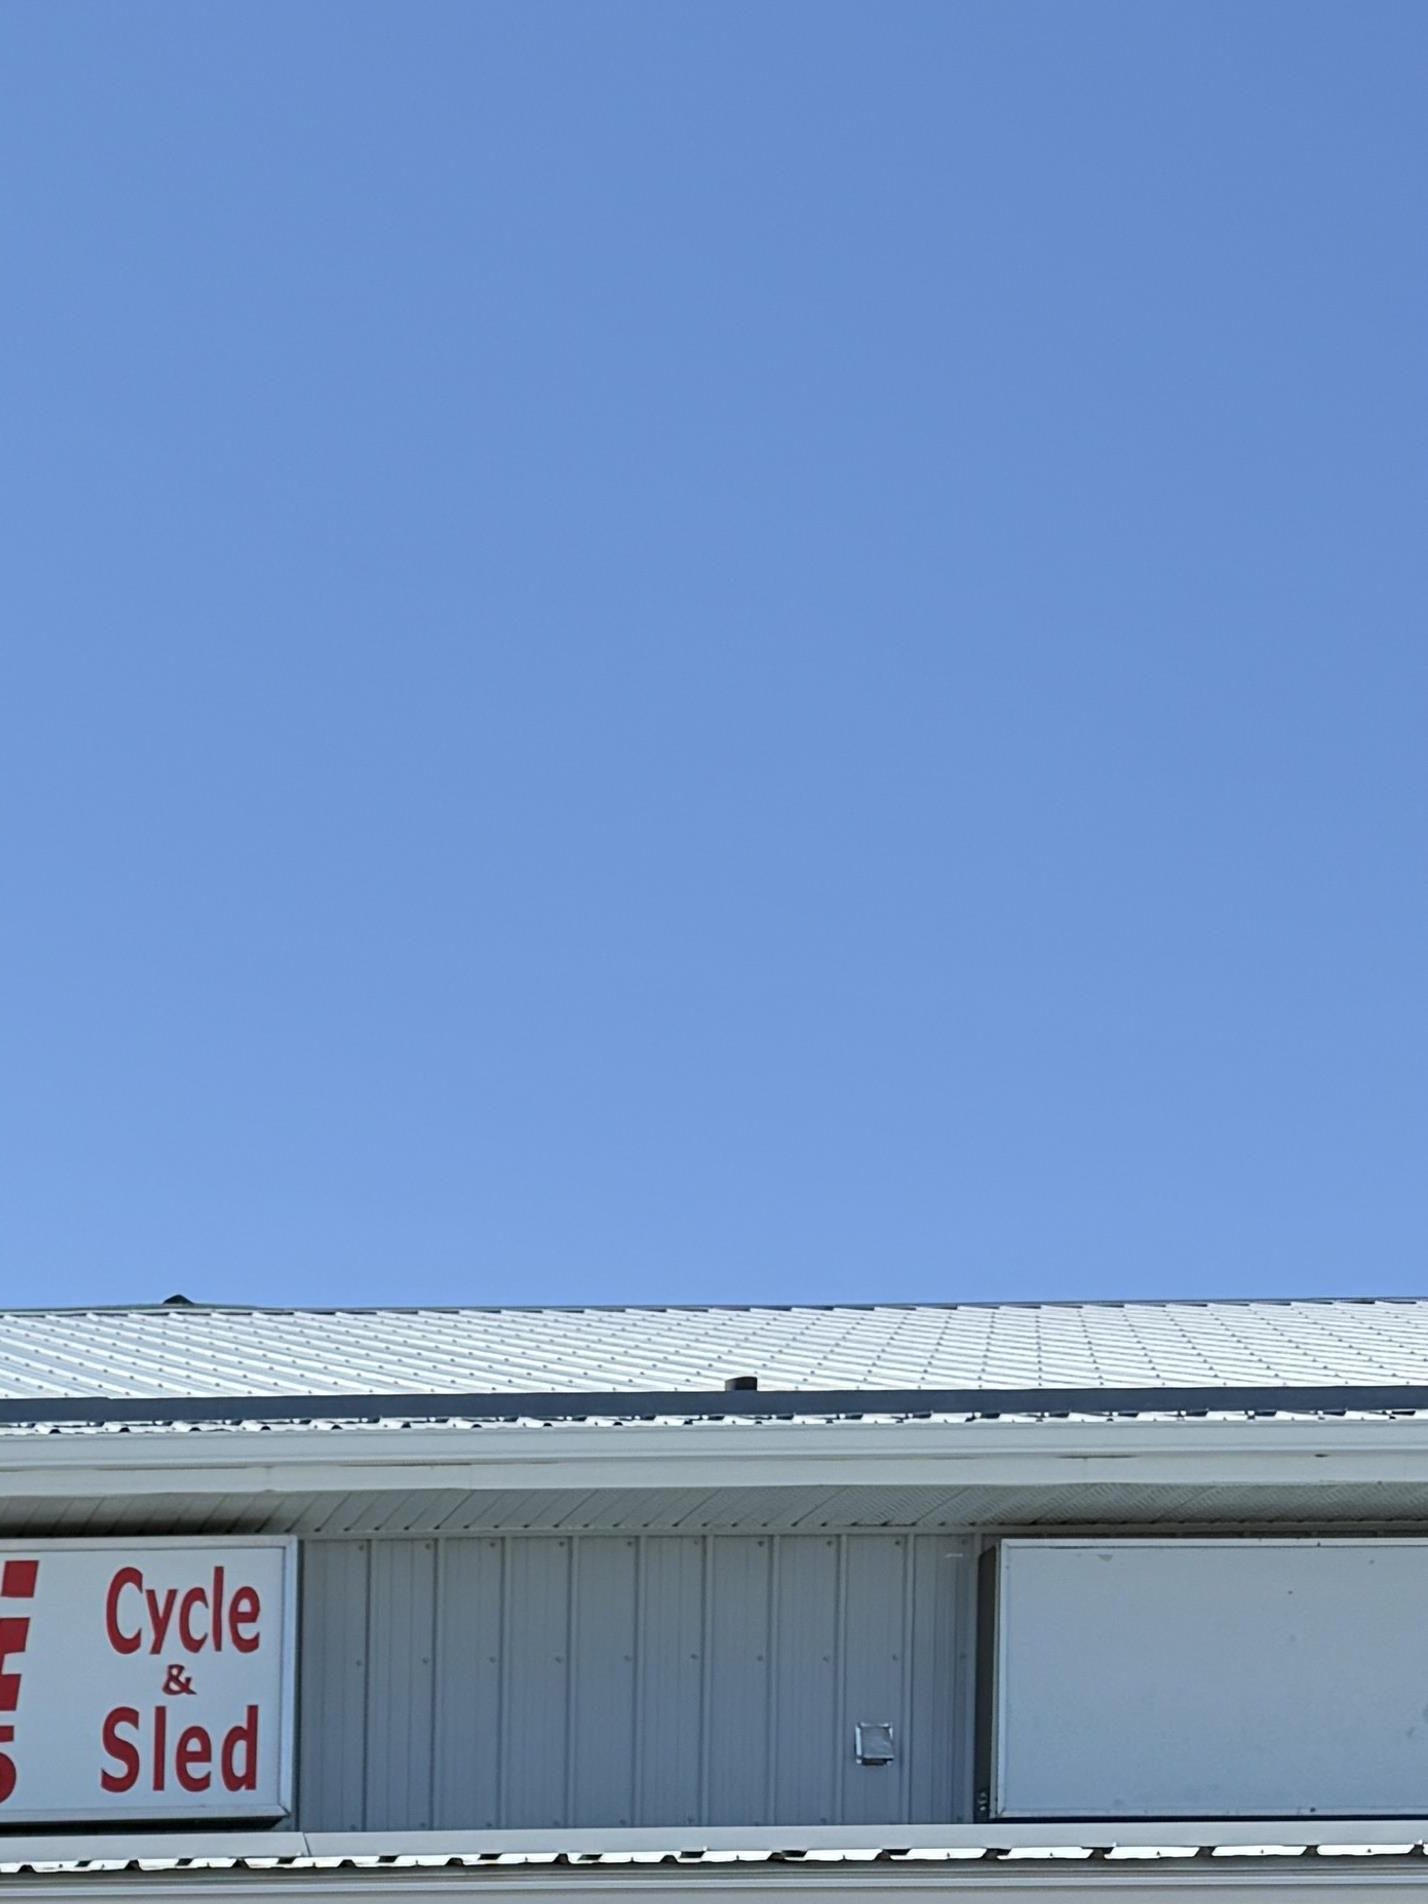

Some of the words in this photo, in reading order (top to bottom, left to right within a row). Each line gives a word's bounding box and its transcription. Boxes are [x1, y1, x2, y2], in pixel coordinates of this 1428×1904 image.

[104, 1566, 262, 1656] Cycle
[161, 1662, 199, 1697] &
[99, 1704, 260, 1794] Sled
